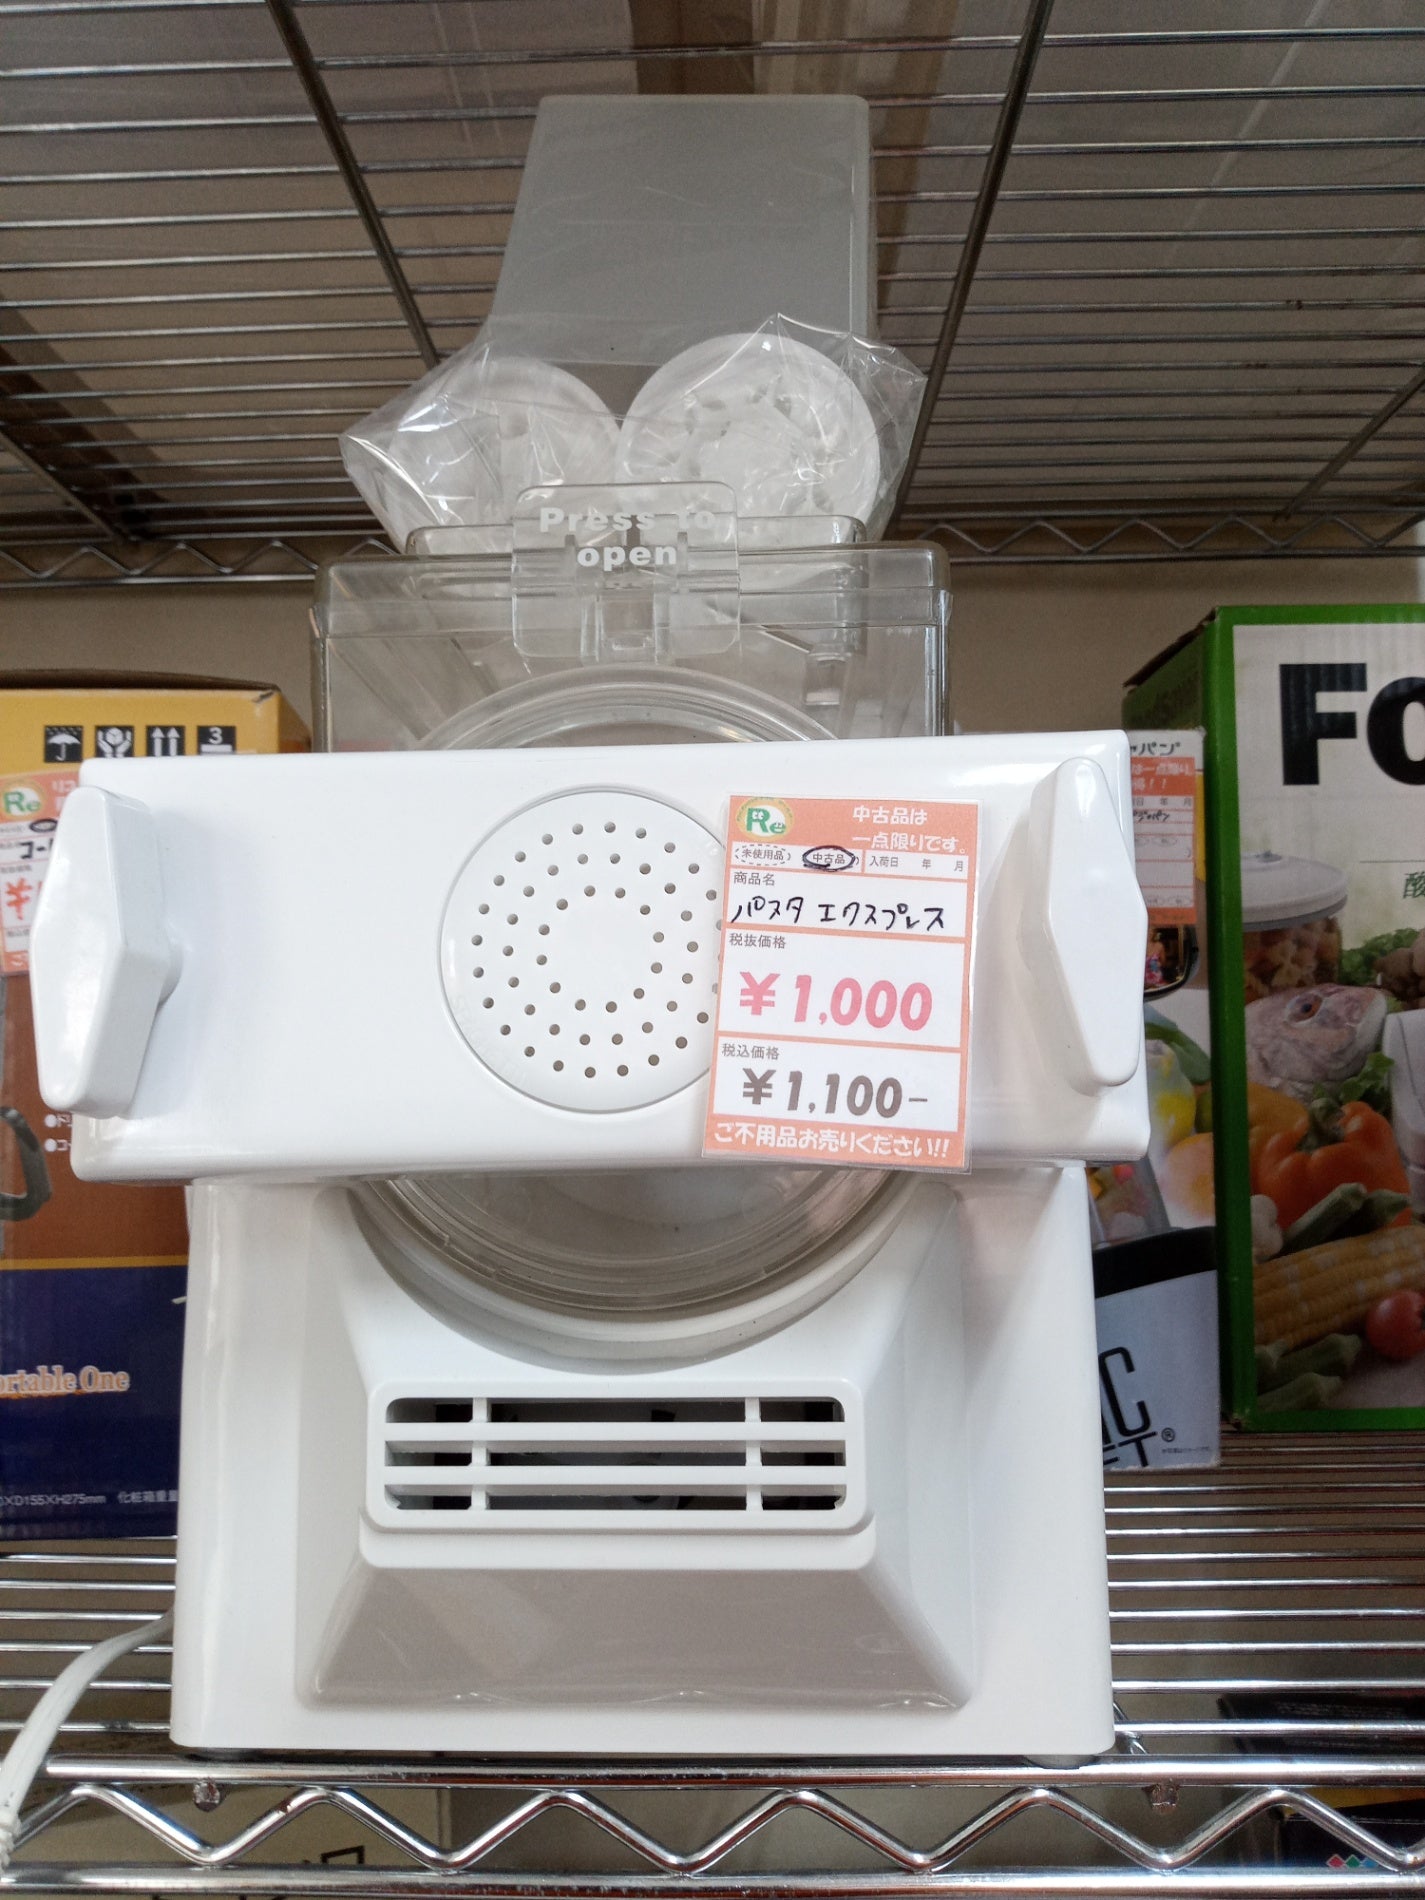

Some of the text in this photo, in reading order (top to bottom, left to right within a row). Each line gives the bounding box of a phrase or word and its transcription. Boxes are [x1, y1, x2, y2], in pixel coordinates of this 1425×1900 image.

[539, 507, 655, 532] Press
[577, 546, 677, 572] open
[209, 727, 222, 744] 3
[4, 791, 41, 815] Re
[746, 808, 786, 834] Re
[853, 805, 927, 825] 中古品は
[852, 832, 966, 854] 一点限りです。
[741, 848, 845, 865] 未使用品 中古品
[869, 856, 964, 872] 入荷日 年 月
[733, 871, 776, 887] 商品名
[731, 895, 944, 931] パスタ エクスプレス
[729, 932, 787, 949] 税抜価格
[739, 971, 932, 1031] ¥1,000
[721, 1042, 780, 1061] 税込価格
[714, 1122, 950, 1158] ご不用品お売りください!!
[79, 1365, 130, 1392] One
